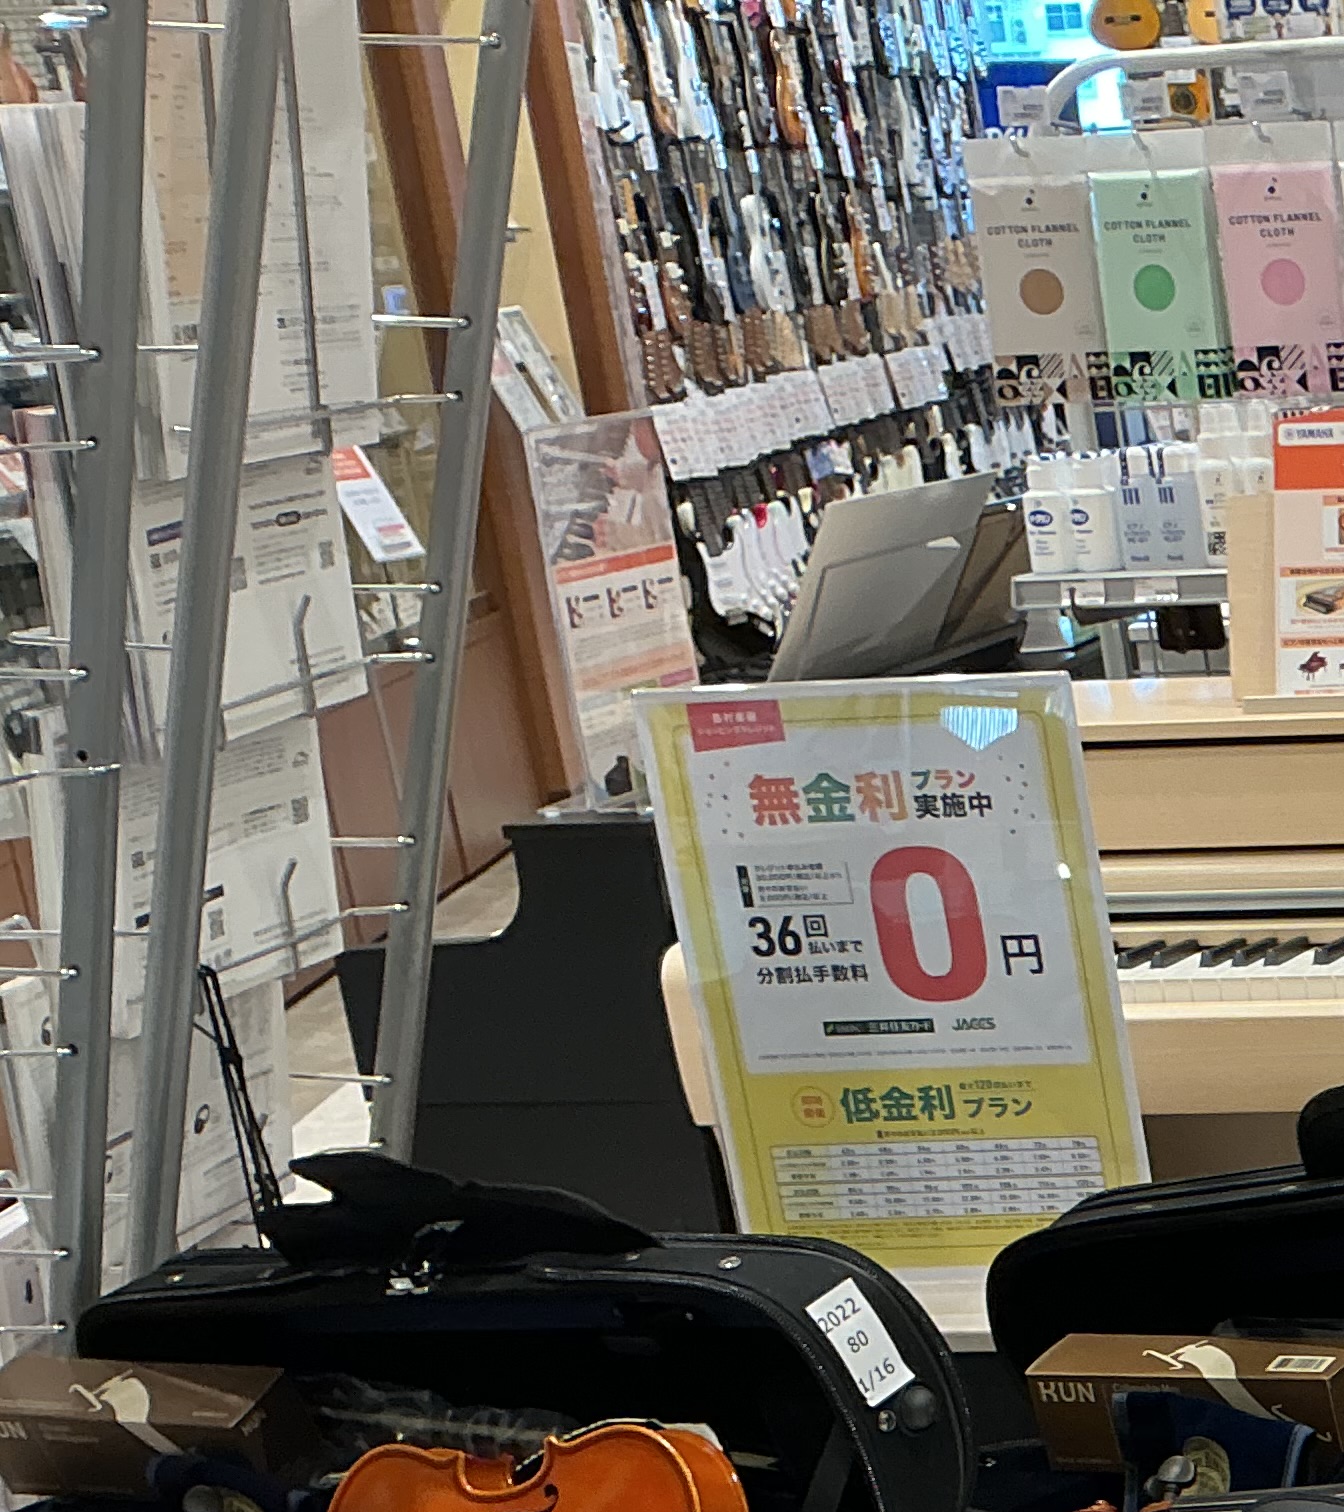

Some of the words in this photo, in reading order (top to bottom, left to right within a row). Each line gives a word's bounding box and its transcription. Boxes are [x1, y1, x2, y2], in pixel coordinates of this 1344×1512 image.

[748, 770, 909, 827] 無金利
[911, 769, 976, 791] プラン
[913, 792, 993, 820] 実施中
[756, 963, 869, 985] 分割払手数料
[841, 1083, 956, 1125] 低金利
[963, 1096, 1033, 1119] プラン
[818, 1298, 861, 1334] 2022
[847, 1330, 869, 1353] 80
[859, 1357, 895, 1393] 1/16
[1037, 1381, 1096, 1403] KUN
